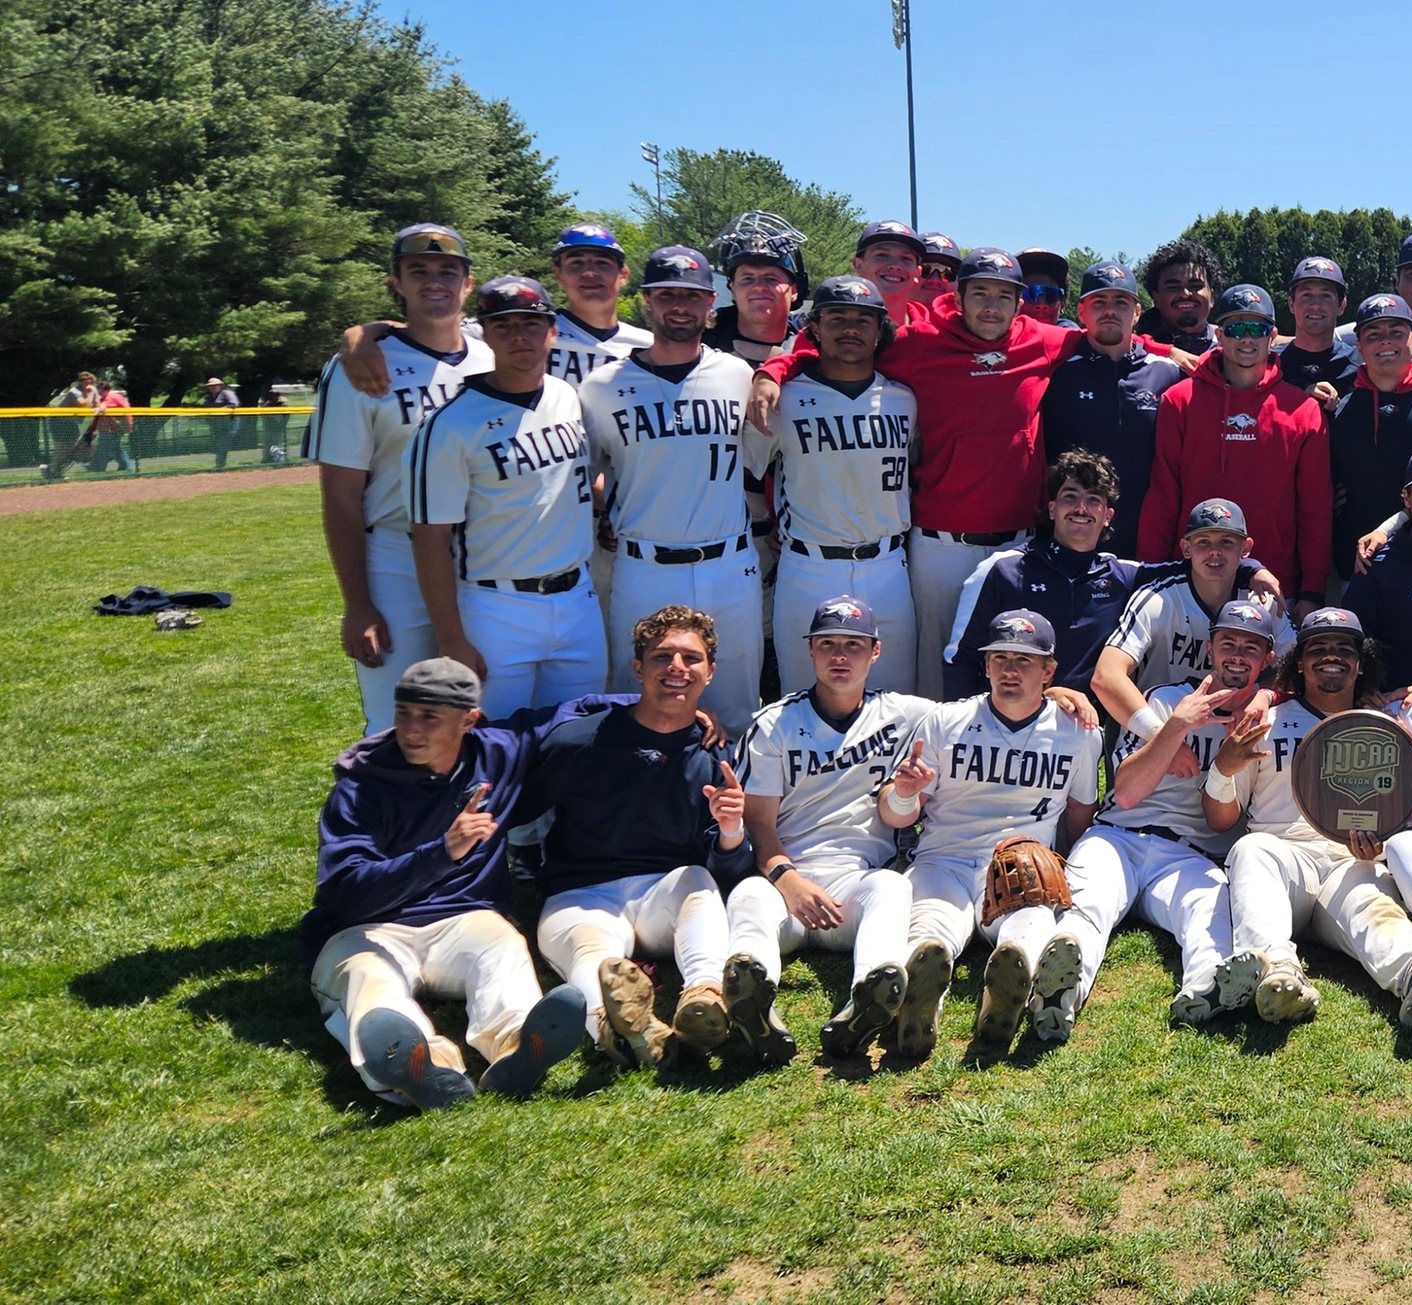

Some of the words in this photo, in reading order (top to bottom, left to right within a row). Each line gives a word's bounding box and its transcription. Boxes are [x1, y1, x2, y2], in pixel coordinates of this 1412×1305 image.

[612, 399, 740, 446] FALCONS
[793, 415, 909, 454] FALCONS
[1221, 433, 1257, 441] ASEBALL
[710, 443, 738, 481] 17
[882, 456, 907, 491] 28
[788, 723, 899, 788] FALCONS
[950, 743, 1073, 790] FALCONS
[1324, 741, 1397, 775] NJCAA
[1336, 777, 1371, 785] REGION
[1378, 776, 1393, 788] 19
[1030, 797, 1052, 822] 4
